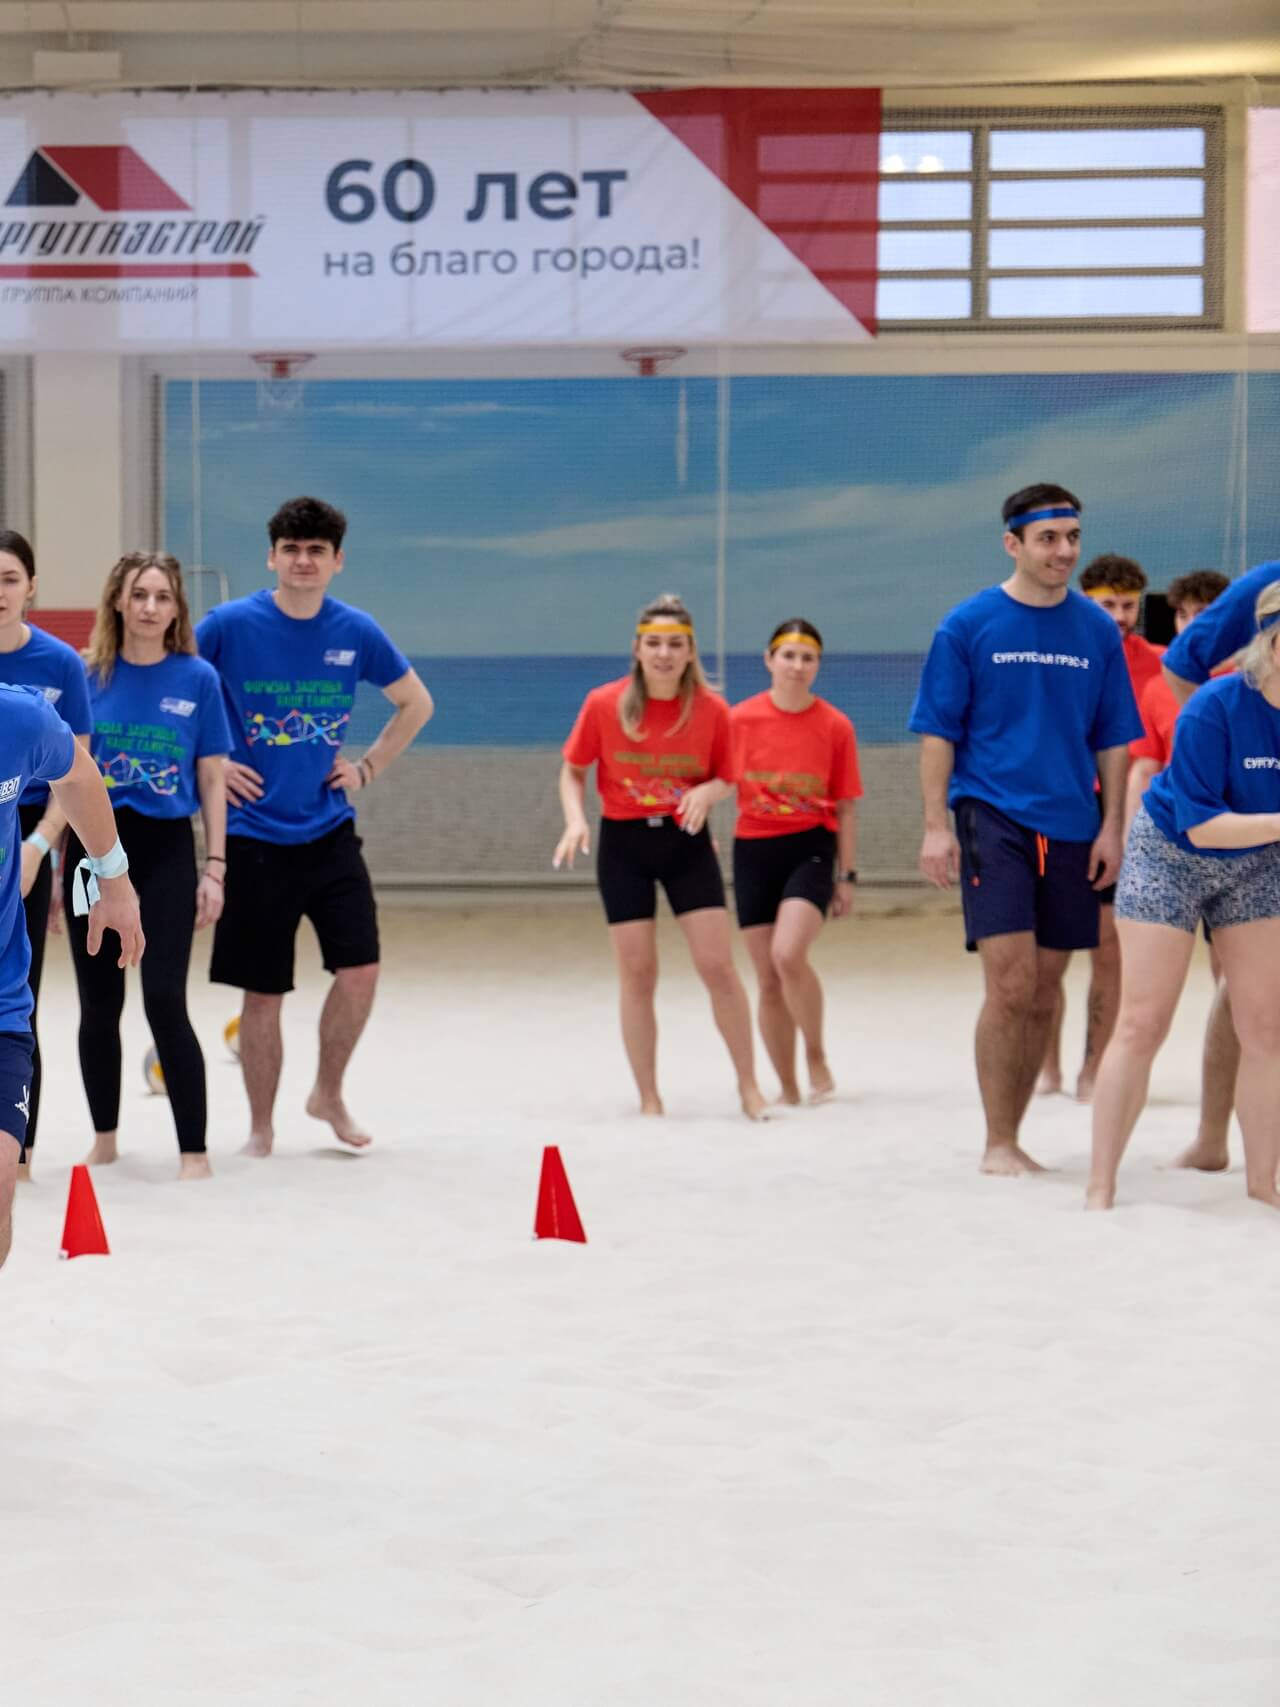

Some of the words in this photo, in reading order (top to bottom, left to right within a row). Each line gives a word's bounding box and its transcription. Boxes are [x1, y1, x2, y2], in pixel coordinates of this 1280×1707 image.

[325, 158, 436, 224] 60
[465, 169, 628, 222] лет
[323, 251, 375, 277] на
[390, 242, 519, 277] благо
[532, 238, 700, 278] города!
